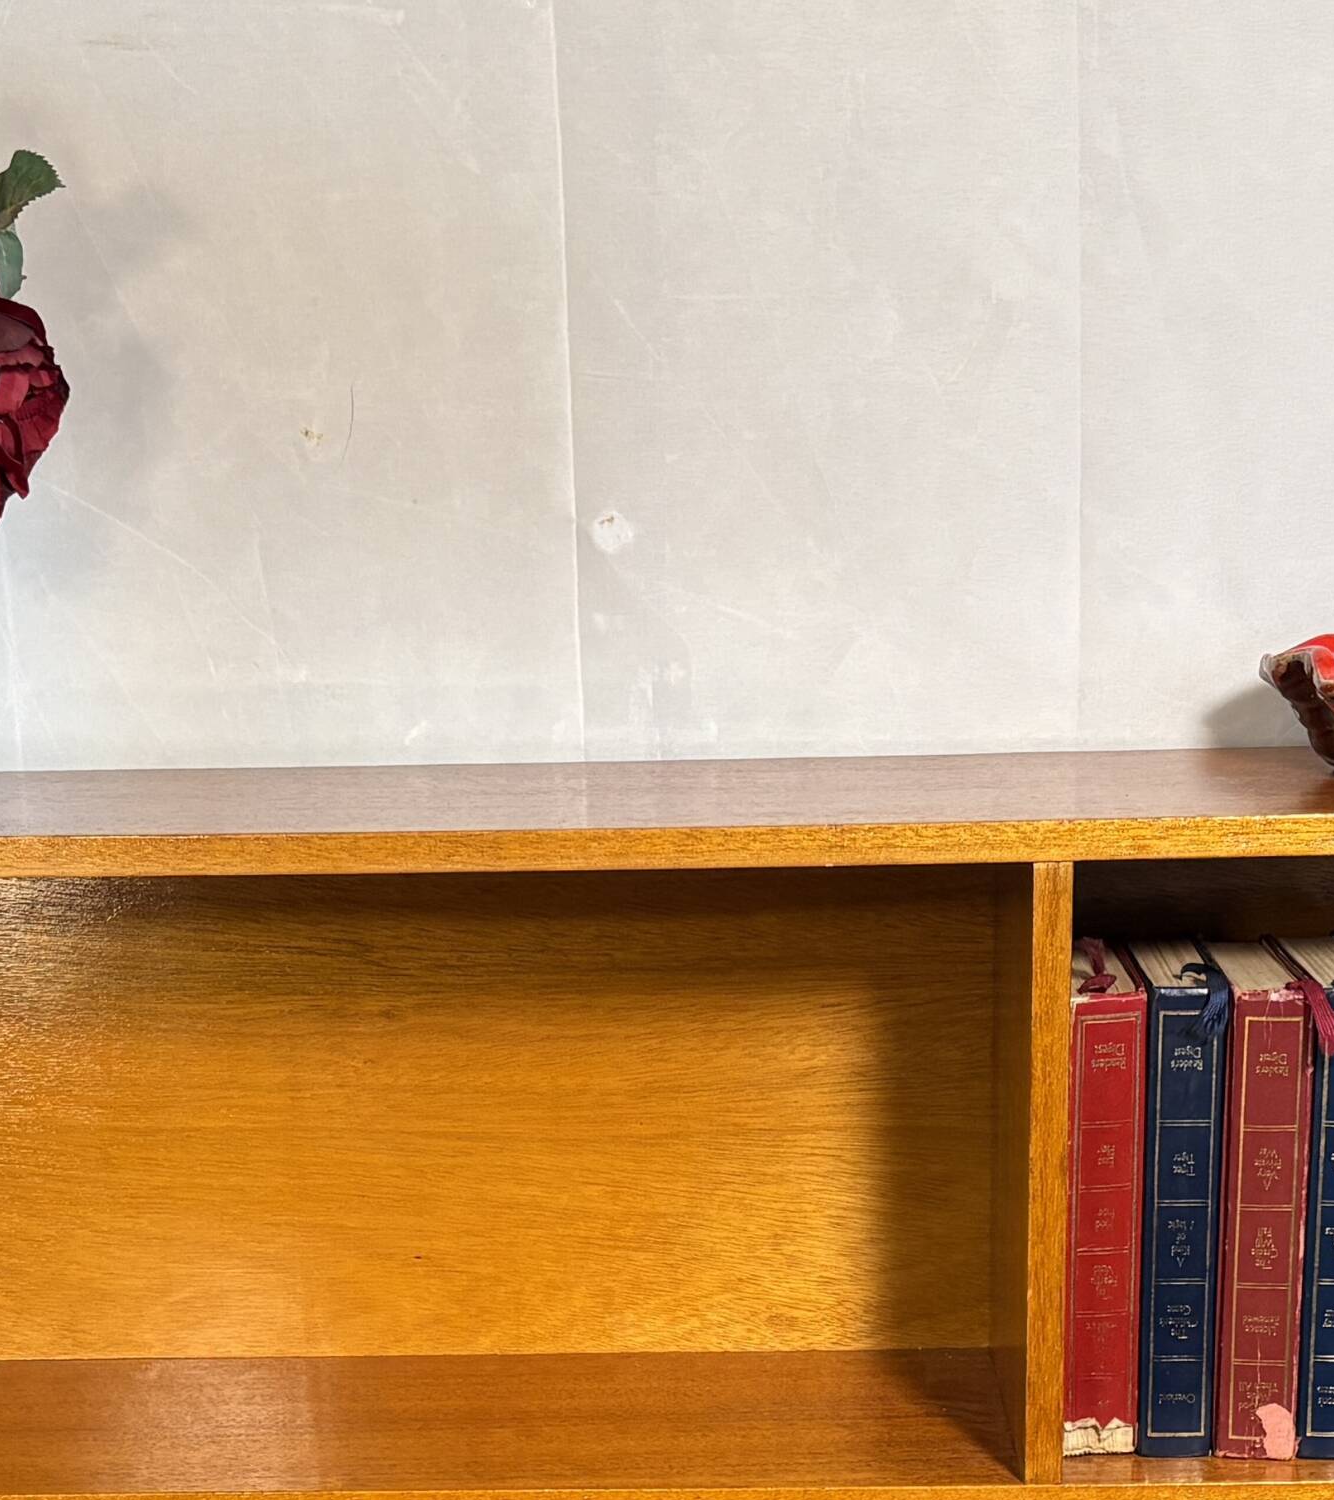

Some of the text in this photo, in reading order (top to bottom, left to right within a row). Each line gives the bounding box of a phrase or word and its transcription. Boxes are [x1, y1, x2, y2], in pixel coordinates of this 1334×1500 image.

[1094, 1041, 1125, 1057] Digest
[1173, 1043, 1201, 1056] Digest
[1172, 1151, 1194, 1163] Tiger
[1263, 1179, 1270, 1191] A
[1170, 1243, 1190, 1255] Kind
[1176, 1256, 1185, 1267] A
